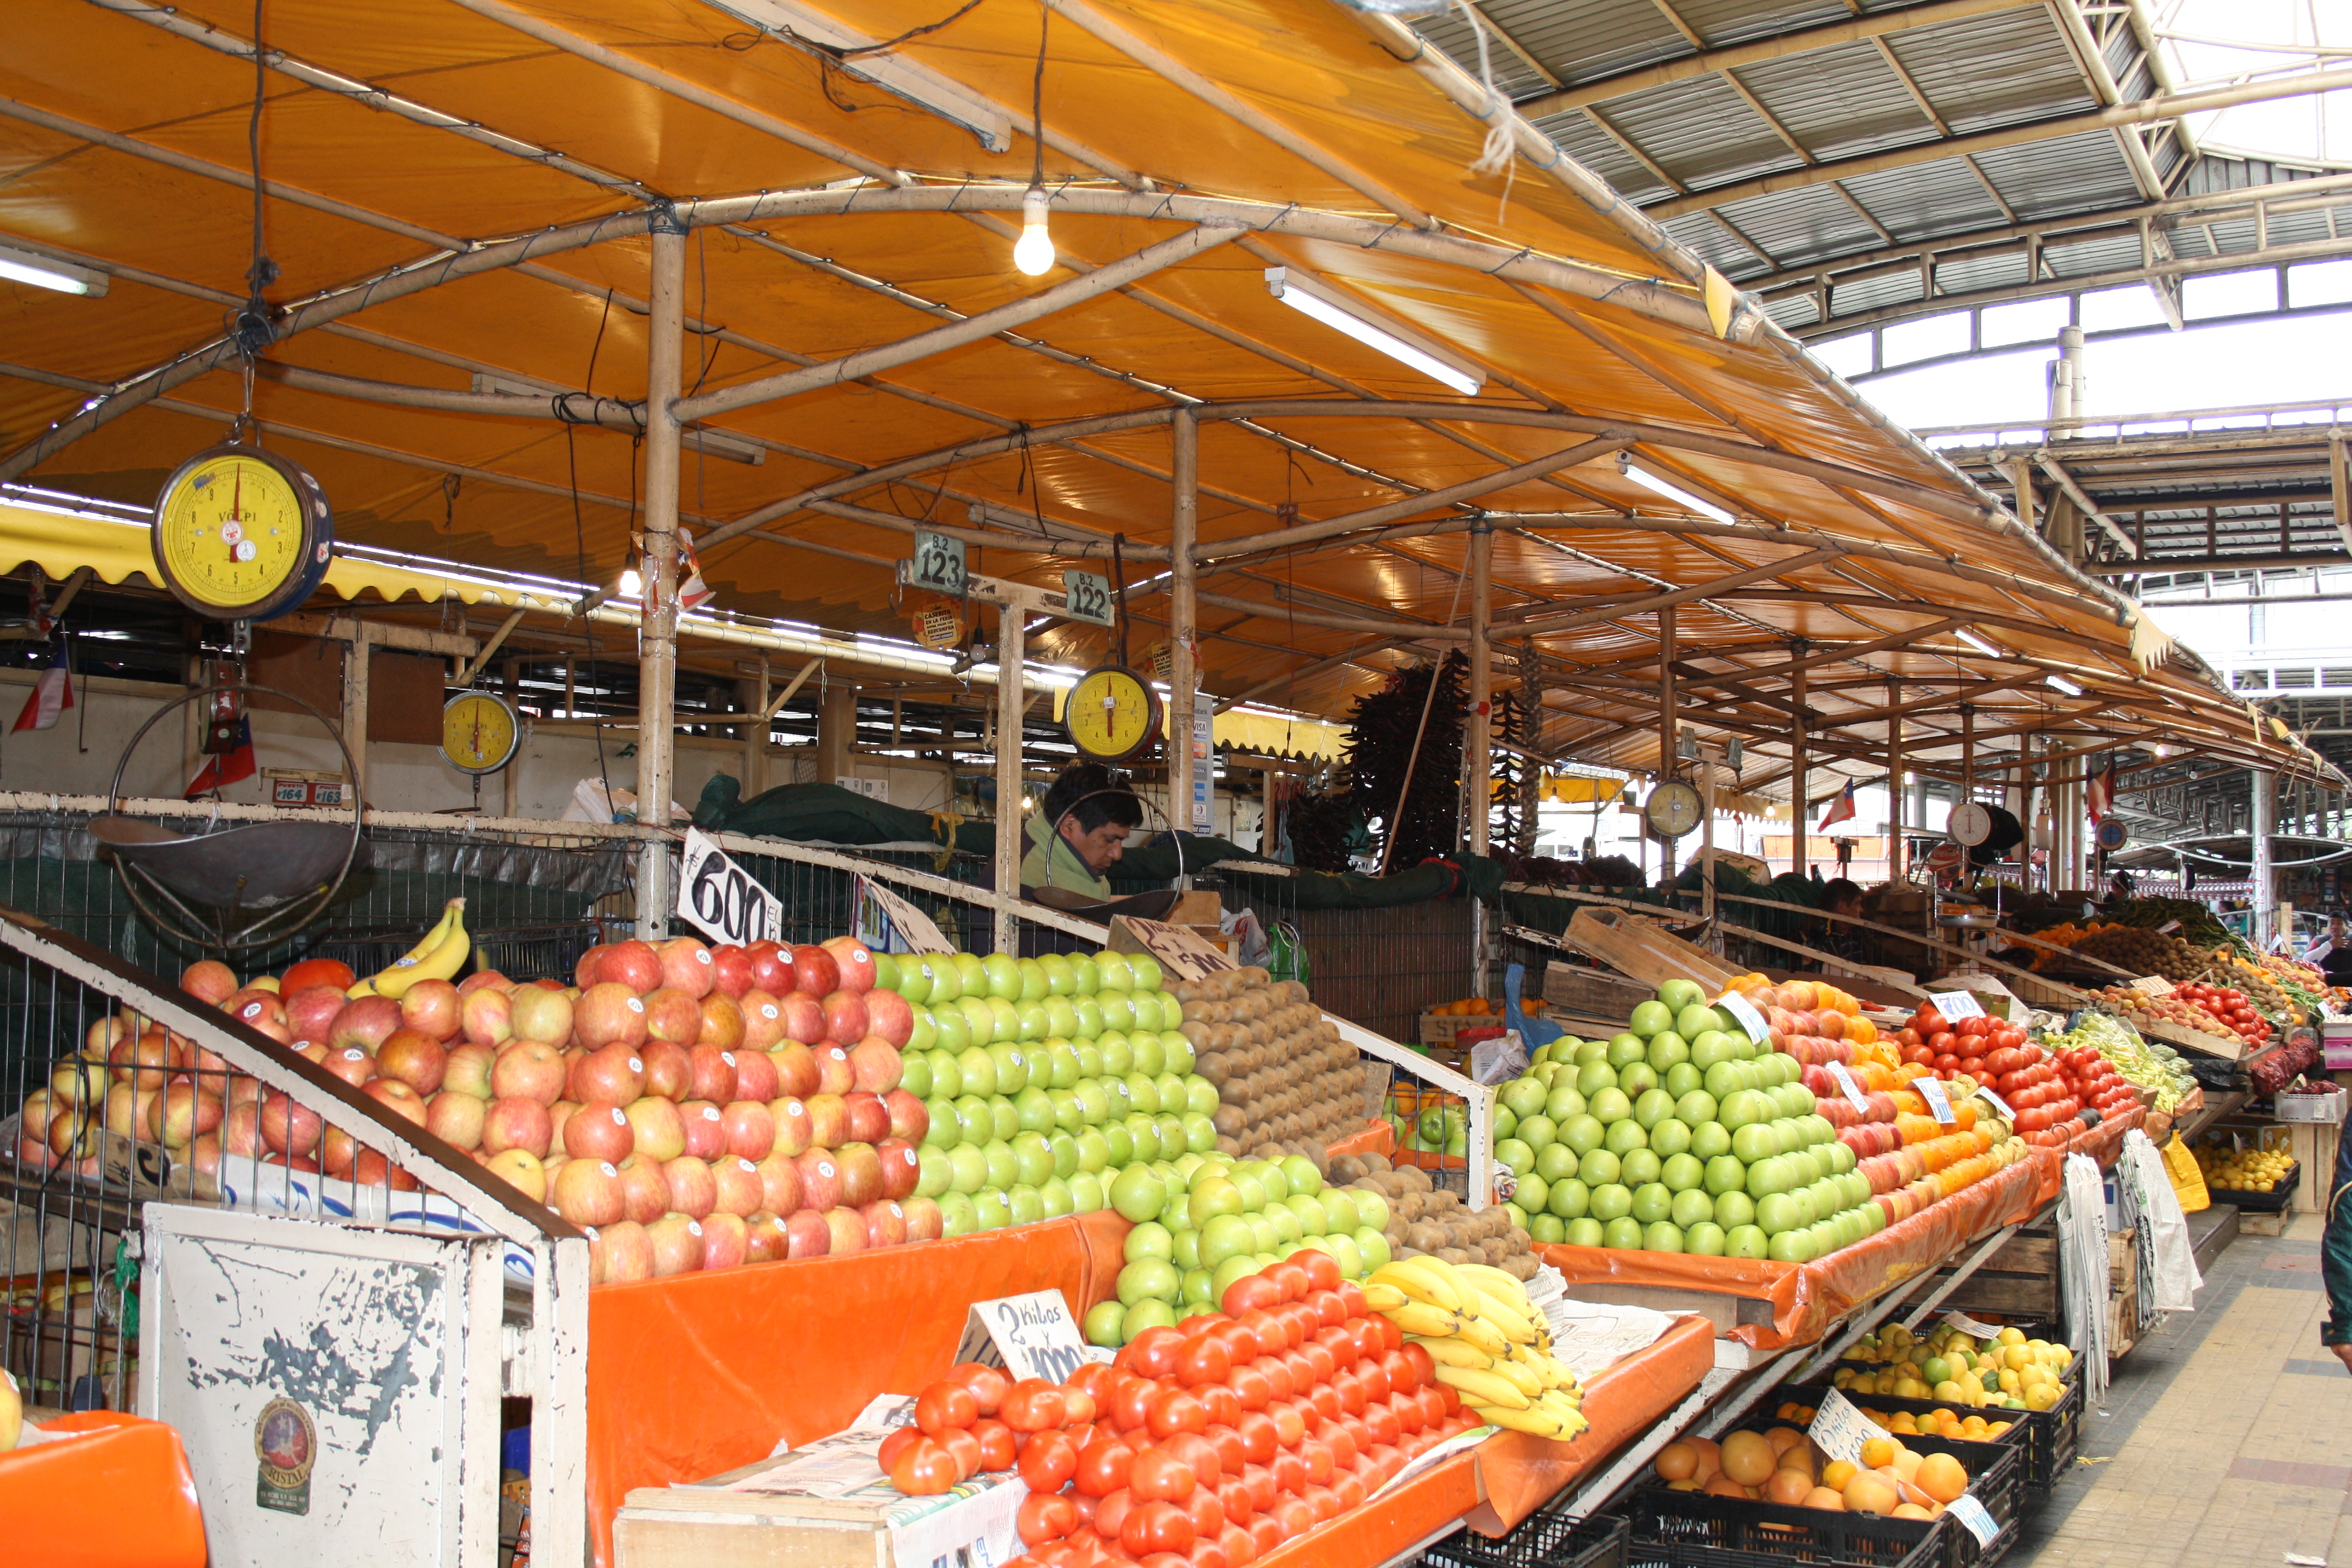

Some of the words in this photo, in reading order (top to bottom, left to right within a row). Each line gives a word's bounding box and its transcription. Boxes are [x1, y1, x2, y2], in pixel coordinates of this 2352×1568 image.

[209, 488, 214, 501] 9
[262, 488, 265, 500] 1
[192, 511, 196, 523] 8
[279, 511, 283, 522] 2
[191, 542, 195, 554] 7
[278, 542, 282, 554] 3
[932, 535, 948, 550] B.2
[208, 564, 212, 577] 6
[260, 564, 263, 576] 4
[920, 548, 961, 587] 123
[234, 572, 238, 584] 5
[1079, 573, 1094, 586] B.2
[1073, 583, 1106, 618] 122
[1194, 722, 1206, 732] VISA
[1126, 916, 1171, 952] 2
[1938, 996, 1976, 1015] 700
[998, 1302, 1027, 1345] 2
[269, 1467, 305, 1485] RISTAL
